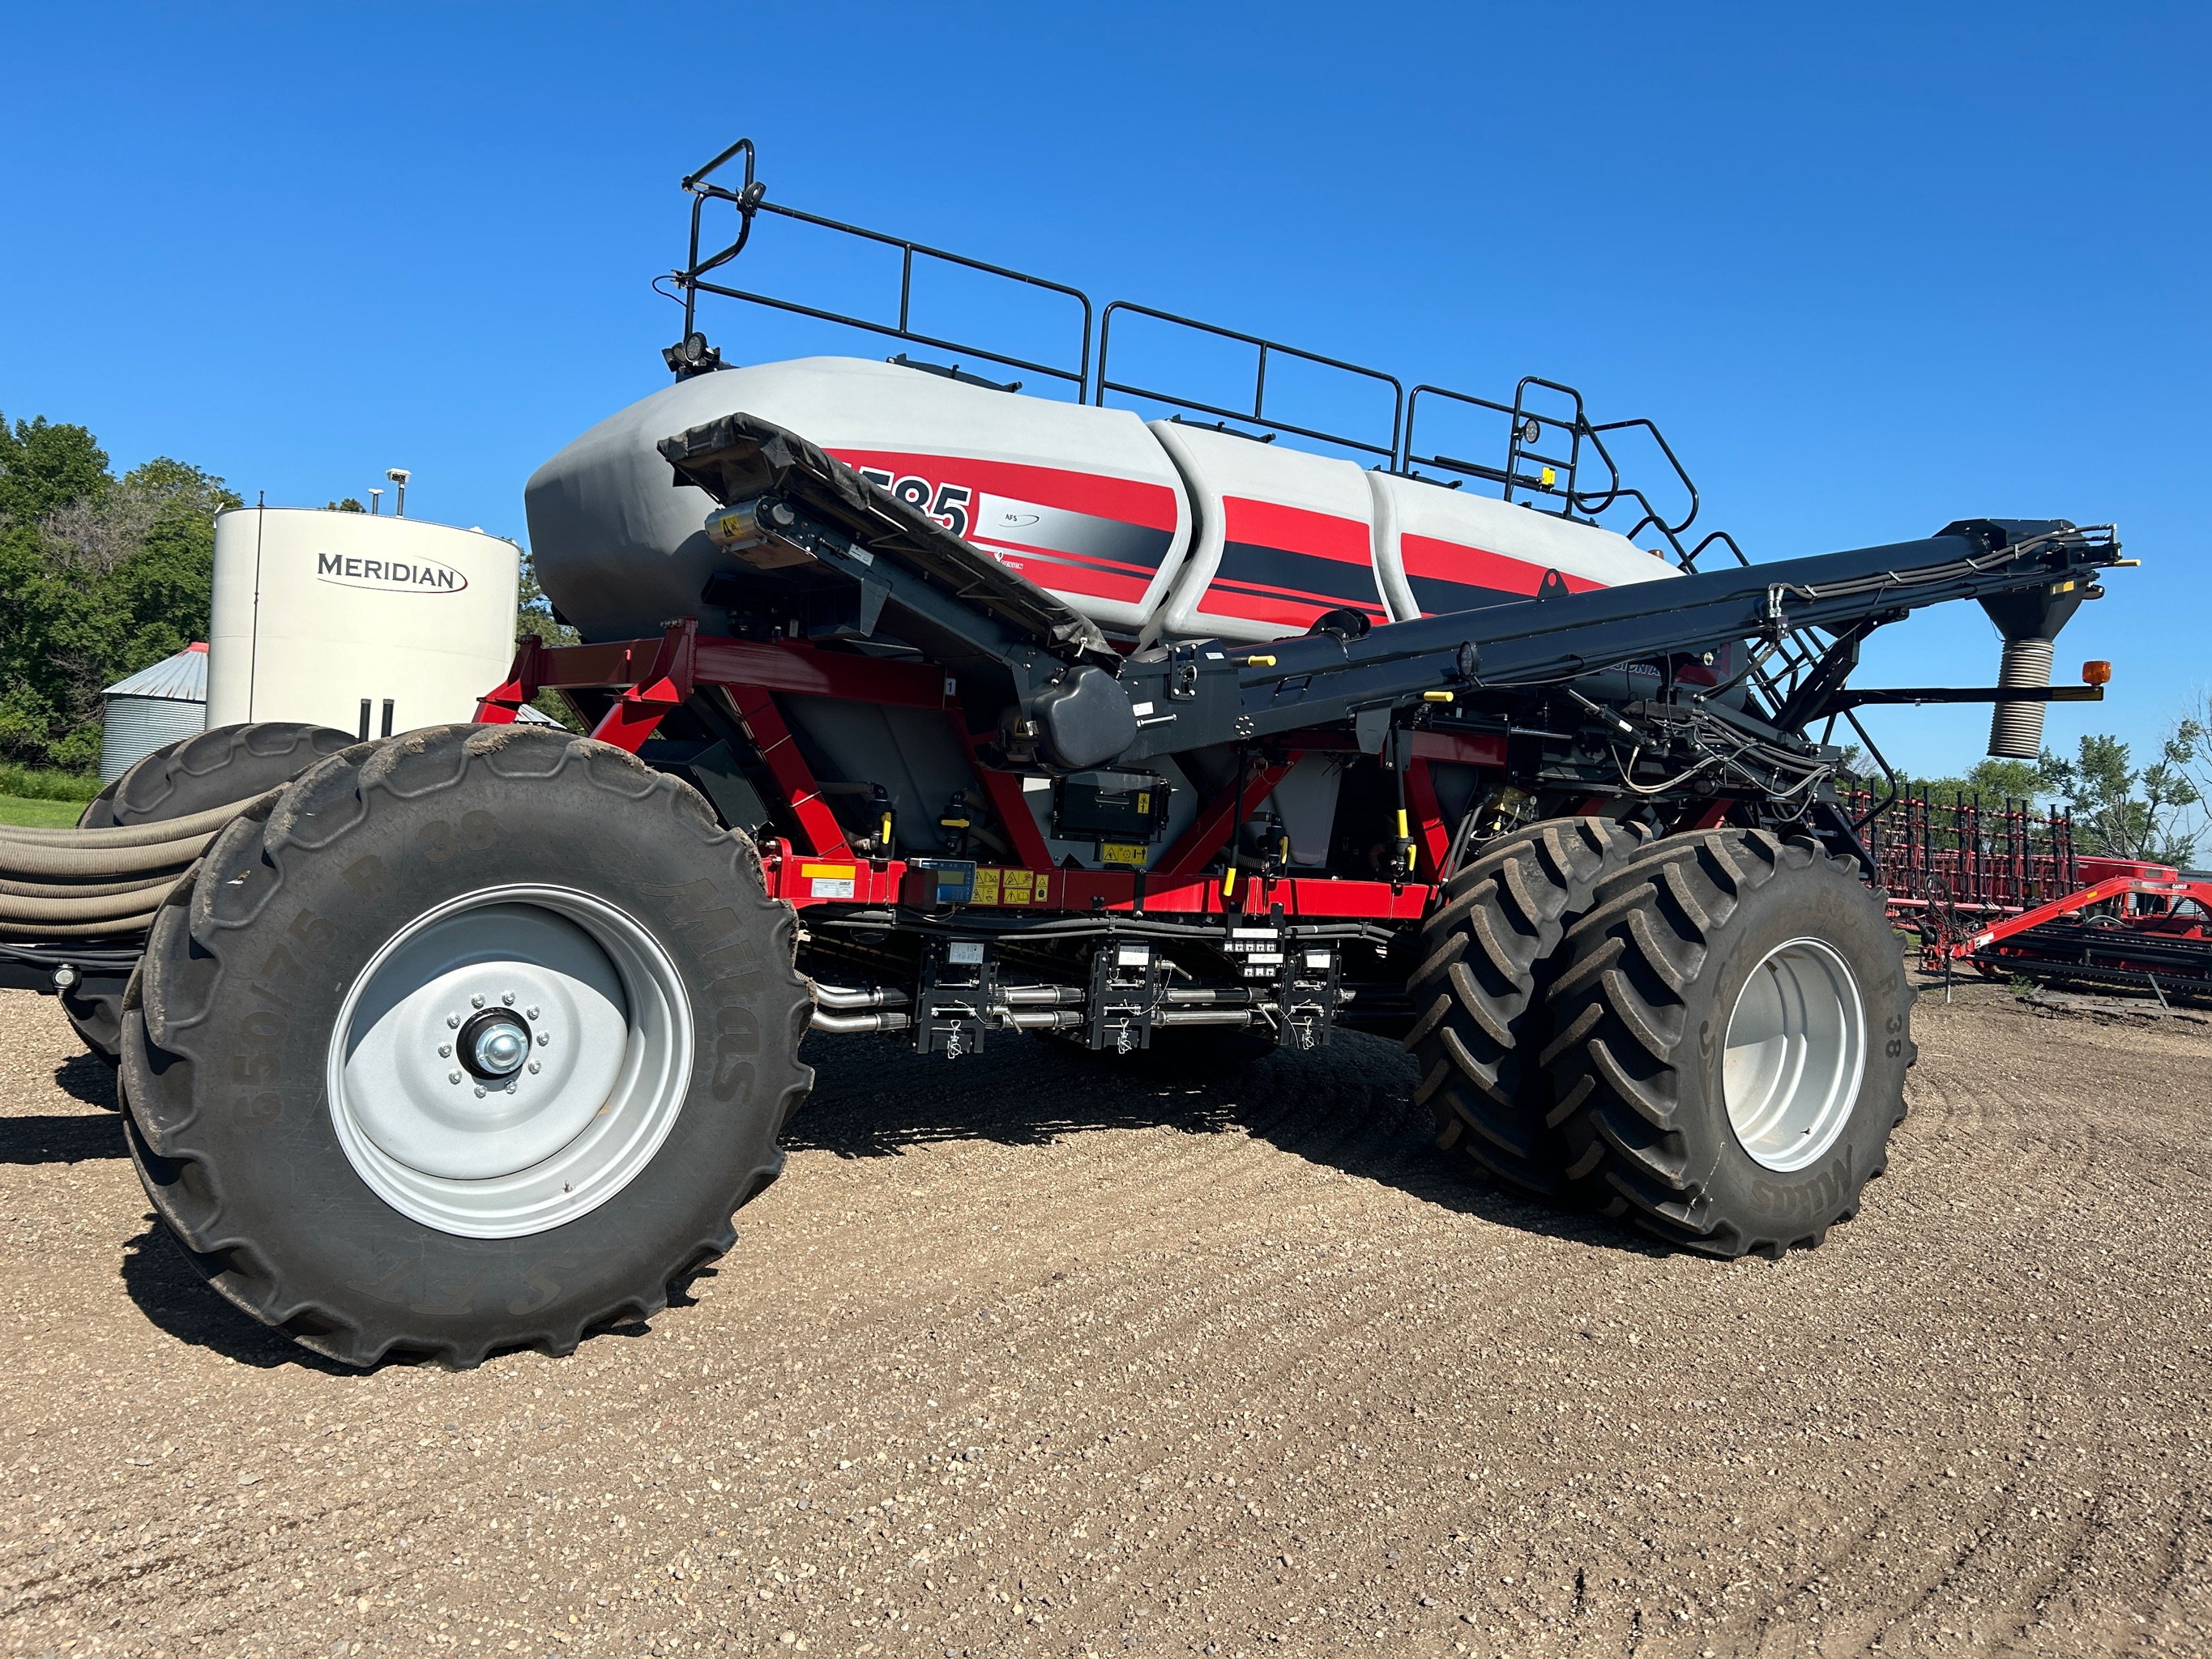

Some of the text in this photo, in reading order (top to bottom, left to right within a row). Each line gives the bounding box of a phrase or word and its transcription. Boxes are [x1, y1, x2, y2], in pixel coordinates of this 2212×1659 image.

[1005, 514, 1018, 522] AFS
[317, 552, 454, 590] MERIDIAN
[947, 681, 953, 693] 1
[232, 808, 497, 1128] 650/75 R 38
[638, 877, 766, 1106] Mitas
[1884, 1013, 1903, 1060] 38
[1749, 1143, 1854, 1225] Mitas
